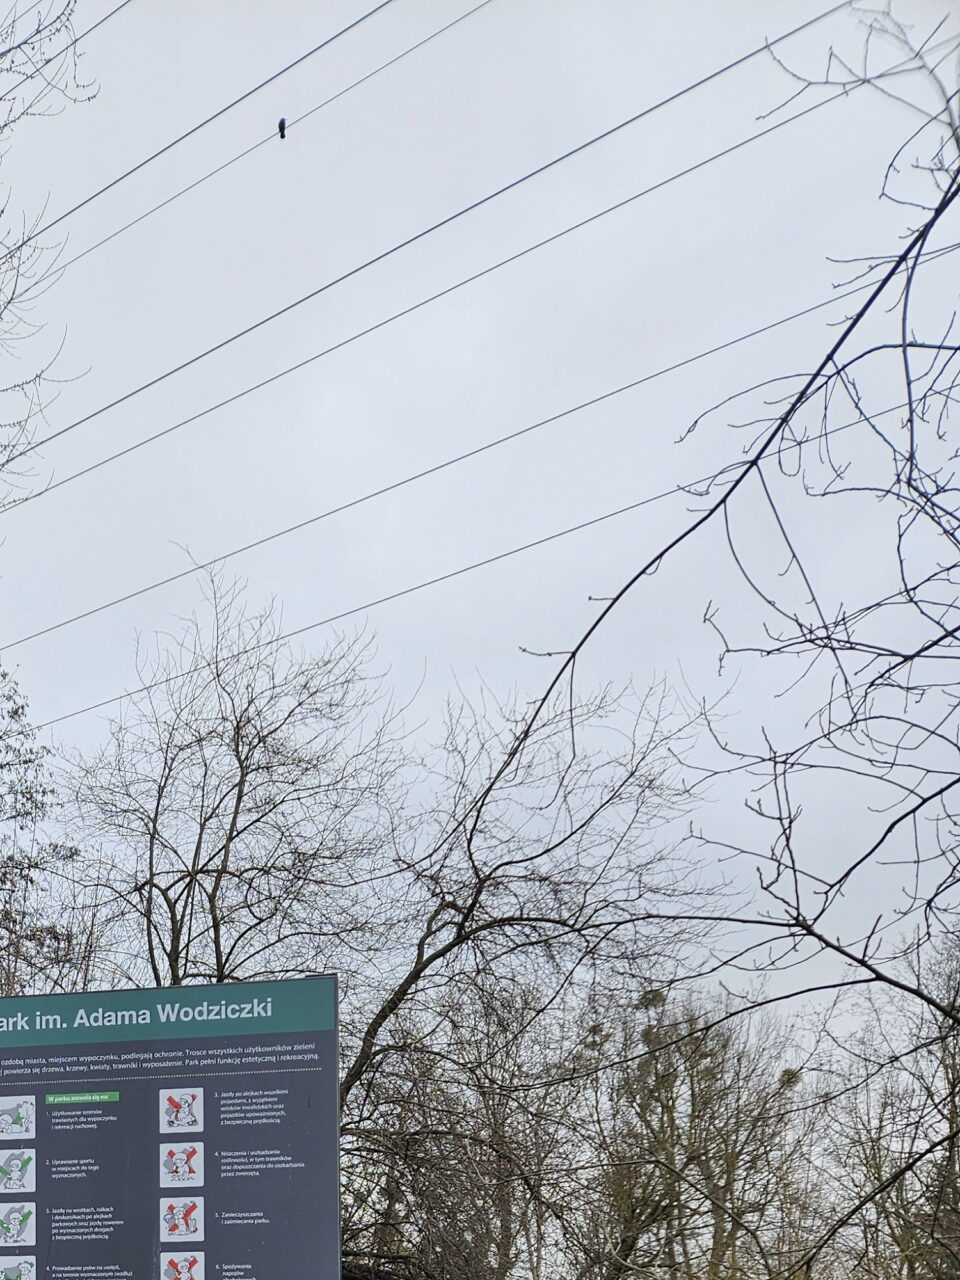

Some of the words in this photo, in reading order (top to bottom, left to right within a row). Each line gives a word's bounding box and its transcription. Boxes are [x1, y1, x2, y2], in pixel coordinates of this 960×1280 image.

[36, 1011, 68, 1029] im.
[73, 1006, 151, 1028] Adama
[157, 997, 272, 1023] Wodziczki
[1, 1058, 23, 1067] ozdobą
[49, 1056, 77, 1064] miejscem
[79, 1054, 119, 1063] wypoczynku,
[122, 1052, 153, 1062] podlegają
[208, 1047, 242, 1056] wszystkich
[244, 1044, 291, 1054] użytkowników
[4, 1067, 31, 1076] powierza
[66, 1064, 89, 1073] krzewy,
[90, 1064, 111, 1072] kwiaty,
[143, 1060, 184, 1069] wyposażenie.
[200, 1058, 216, 1066] pełni
[218, 1057, 241, 1066] funkcję
[242, 1055, 275, 1064] estetyczną
[281, 1053, 320, 1063] rekreacyjną.
